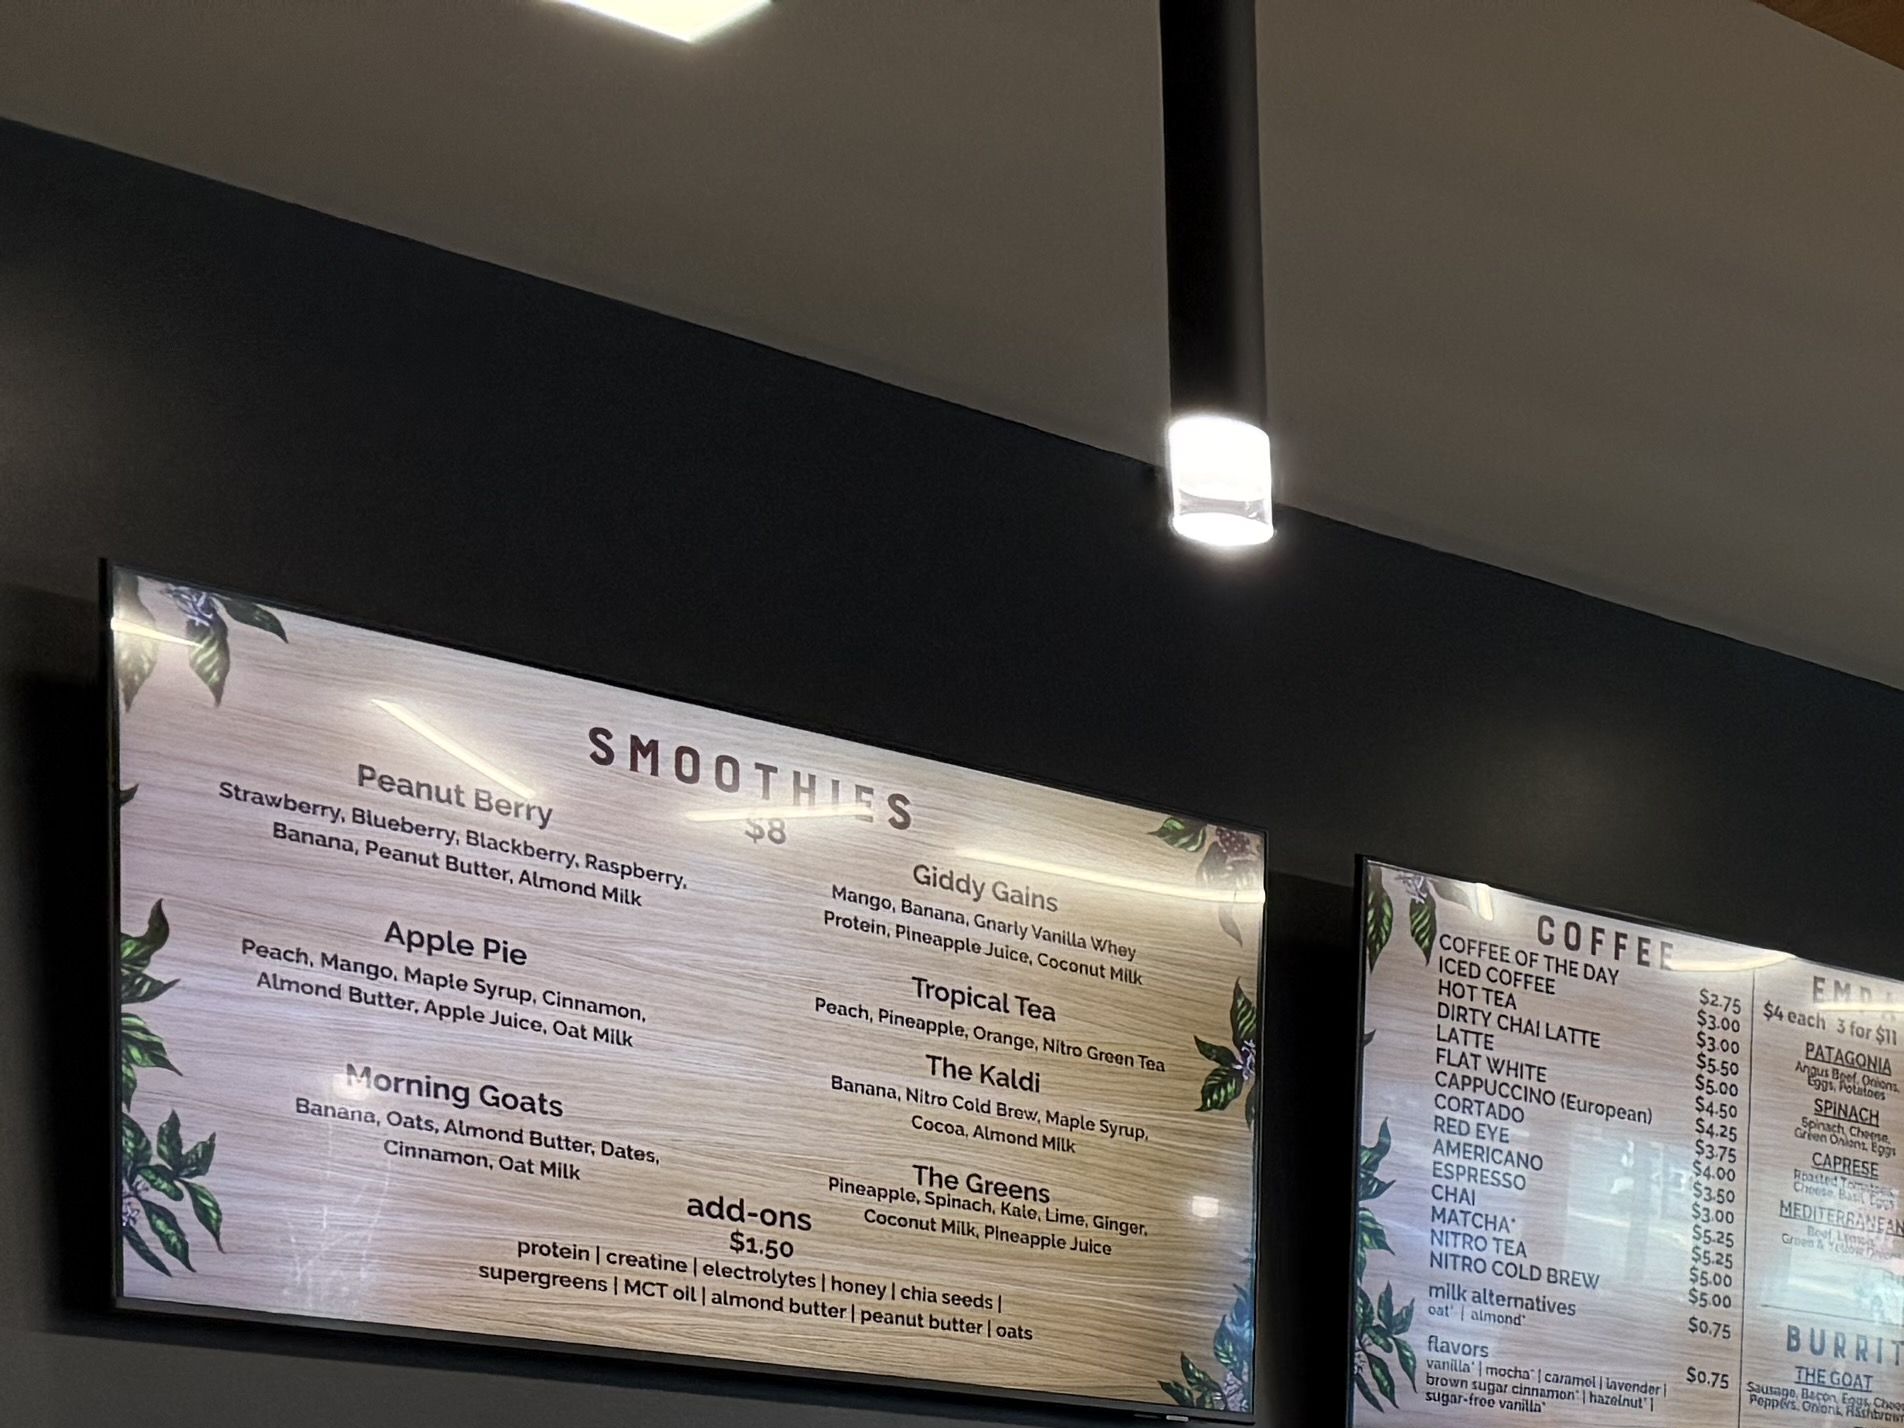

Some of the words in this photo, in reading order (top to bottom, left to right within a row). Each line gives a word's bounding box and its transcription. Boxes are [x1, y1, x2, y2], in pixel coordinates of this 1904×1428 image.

[357, 763, 466, 808] Peanut
[474, 787, 553, 830] Berry
[588, 727, 912, 831] SMOOTHIES
[218, 781, 345, 824] Strawberry,
[351, 806, 459, 846] Blueberry,
[465, 828, 579, 869] Blackberry,
[584, 852, 686, 890] Raspberry,
[745, 817, 787, 845] $8
[912, 863, 986, 902] Giddy
[991, 880, 1058, 912] Gains
[383, 920, 474, 956] Apple
[483, 936, 527, 966] Pie
[831, 883, 896, 913] Mango,
[900, 897, 969, 927] Banana,
[973, 913, 1028, 940] Gnarly
[1030, 923, 1086, 949] Vanilla
[1090, 935, 1136, 962] Whey
[1538, 915, 1673, 971] COFFEE
[241, 937, 314, 968] Peach,
[320, 951, 397, 981] Mango,
[404, 965, 468, 991] Maple
[472, 977, 536, 1005] Syrup,
[542, 989, 646, 1023] Cinnamon,
[1437, 977, 1478, 1002] HOT
[1480, 986, 1517, 1010] TEA
[1438, 933, 1510, 963] COFFEE
[1514, 949, 1539, 968] OF
[1542, 954, 1578, 978] THE
[1582, 962, 1619, 985] DAY
[1700, 988, 1741, 1014] $2.75
[1438, 955, 1481, 979] ICED
[1485, 965, 1555, 995] COFFEE
[1697, 1009, 1740, 1033] $3.00
[910, 975, 1010, 1014] Tropical
[1013, 994, 1056, 1022] Tea
[1436, 1023, 1494, 1051] LATTE
[1436, 1000, 1492, 1027] DIRTY
[1496, 1013, 1540, 1037] CHAI
[1545, 1021, 1600, 1049] LATTE
[1696, 1053, 1739, 1076] $5.50
[1763, 1001, 1785, 1022] $4
[1788, 1011, 1826, 1030] each
[1837, 1018, 1846, 1034] 3
[1850, 1021, 1870, 1039] for
[1875, 1025, 1897, 1046] $11
[924, 1053, 973, 1081] The
[979, 1063, 1040, 1093] Kaldi
[1806, 1042, 1892, 1075] PATAGONIA
[346, 1062, 470, 1109] Morning
[478, 1084, 563, 1117] Goats
[1434, 1070, 1556, 1106] CAPPUCCINO
[1560, 1091, 1652, 1125] (European)
[1436, 1046, 1482, 1071] FLAT
[1485, 1055, 1547, 1083] WHITE
[1695, 1095, 1737, 1119] $4.50
[1433, 1092, 1524, 1123] CORTADO
[1433, 1114, 1470, 1136] RED
[1475, 1121, 1509, 1144] EYE
[1815, 1098, 1879, 1125] SPINACH
[910, 1114, 968, 1138] Cocoa,
[972, 1124, 1038, 1148] Almond
[1041, 1134, 1076, 1154] Milk
[1432, 1137, 1543, 1171] AMERICANO
[383, 1139, 493, 1170] Cinnamon,
[498, 1154, 534, 1174] Oat
[539, 1159, 580, 1180] Milk
[1432, 1159, 1526, 1190] ESPRESSO
[1812, 1153, 1879, 1176] CAPRESE
[911, 1163, 959, 1190] The
[965, 1172, 1050, 1204] Greens
[1430, 1183, 1475, 1206] CHAI
[686, 1194, 812, 1231] add-ons
[863, 1208, 936, 1232] Coconut
[940, 1217, 979, 1239] Milk,
[984, 1224, 1066, 1250] Pineapple
[1069, 1235, 1112, 1255] Juice
[729, 1229, 794, 1260] $1.50
[1430, 1227, 1488, 1252] NITRO
[1491, 1236, 1527, 1258] TEA
[517, 1240, 590, 1261] protein
[605, 1251, 688, 1273] creatine
[702, 1259, 816, 1289] electrolytes
[830, 1274, 886, 1301] honey
[900, 1284, 937, 1303] chia
[941, 1292, 993, 1309] seeds
[1429, 1250, 1486, 1274] NITRO
[1491, 1259, 1542, 1281] COLD
[1546, 1266, 1600, 1289] BREW
[1428, 1283, 1467, 1302] milk
[1471, 1287, 1576, 1316] alternatives
[1688, 1316, 1731, 1339] $0.75
[1427, 1334, 1488, 1358] flavors
[1687, 1366, 1729, 1389] $0.75
[1795, 1366, 1827, 1384] THE
[1830, 1370, 1873, 1391] GOAT
